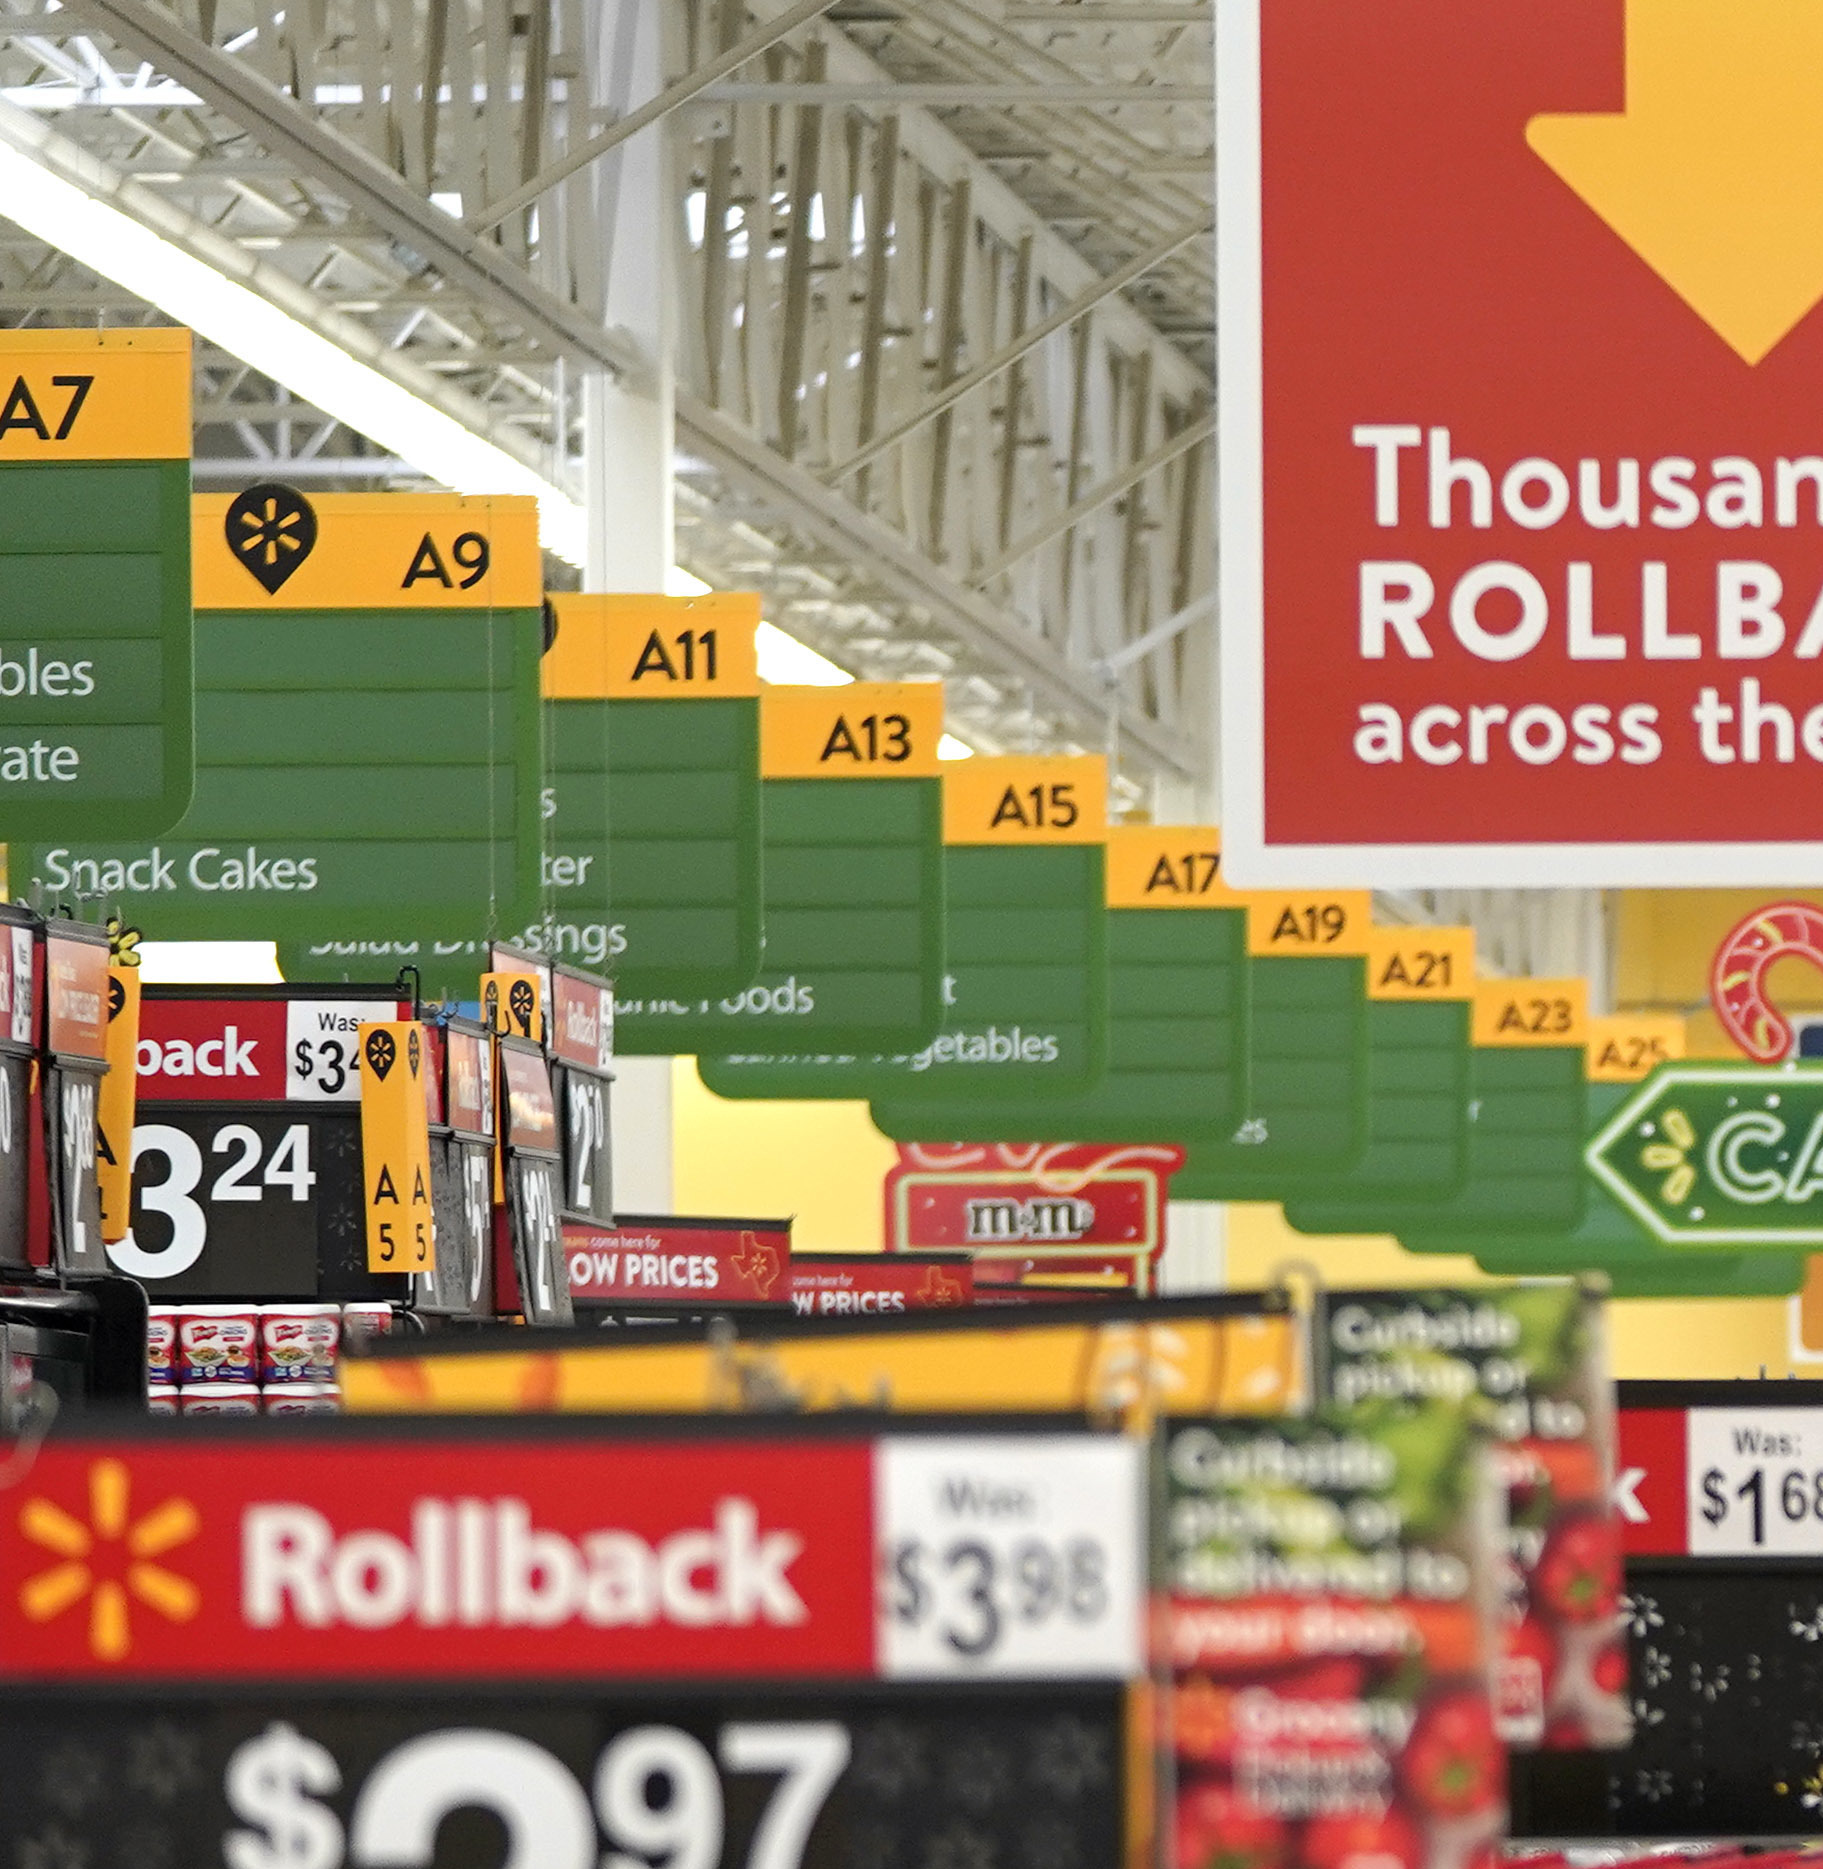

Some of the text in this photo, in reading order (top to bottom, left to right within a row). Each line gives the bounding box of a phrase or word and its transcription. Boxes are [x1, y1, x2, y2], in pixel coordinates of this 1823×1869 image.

[0, 375, 94, 441] A7
[401, 531, 490, 589] A9
[0, 647, 95, 696] bles
[631, 630, 718, 680] A11
[821, 716, 913, 762] A13
[1352, 702, 1663, 766] across
[0, 740, 80, 781] ate
[991, 784, 1079, 828] A15
[44, 846, 319, 892] Snack Cakes
[1145, 852, 1221, 894] A17
[1271, 905, 1346, 944] A19
[1381, 951, 1453, 988] A21
[1496, 998, 1573, 1034] A23
[136, 1025, 260, 1078] back
[872, 1024, 1059, 1073] getables
[1596, 1036, 1668, 1069] A25
[373, 1163, 400, 1206] A
[380, 1223, 396, 1263] 5
[624, 1253, 720, 1289] PRICES
[1333, 1303, 1520, 1356] Curbside
[1334, 1353, 1475, 1402] pickup
[1732, 1427, 1804, 1457] Was:
[241, 1497, 810, 1632] Rollback
[882, 1532, 1110, 1661] $398
